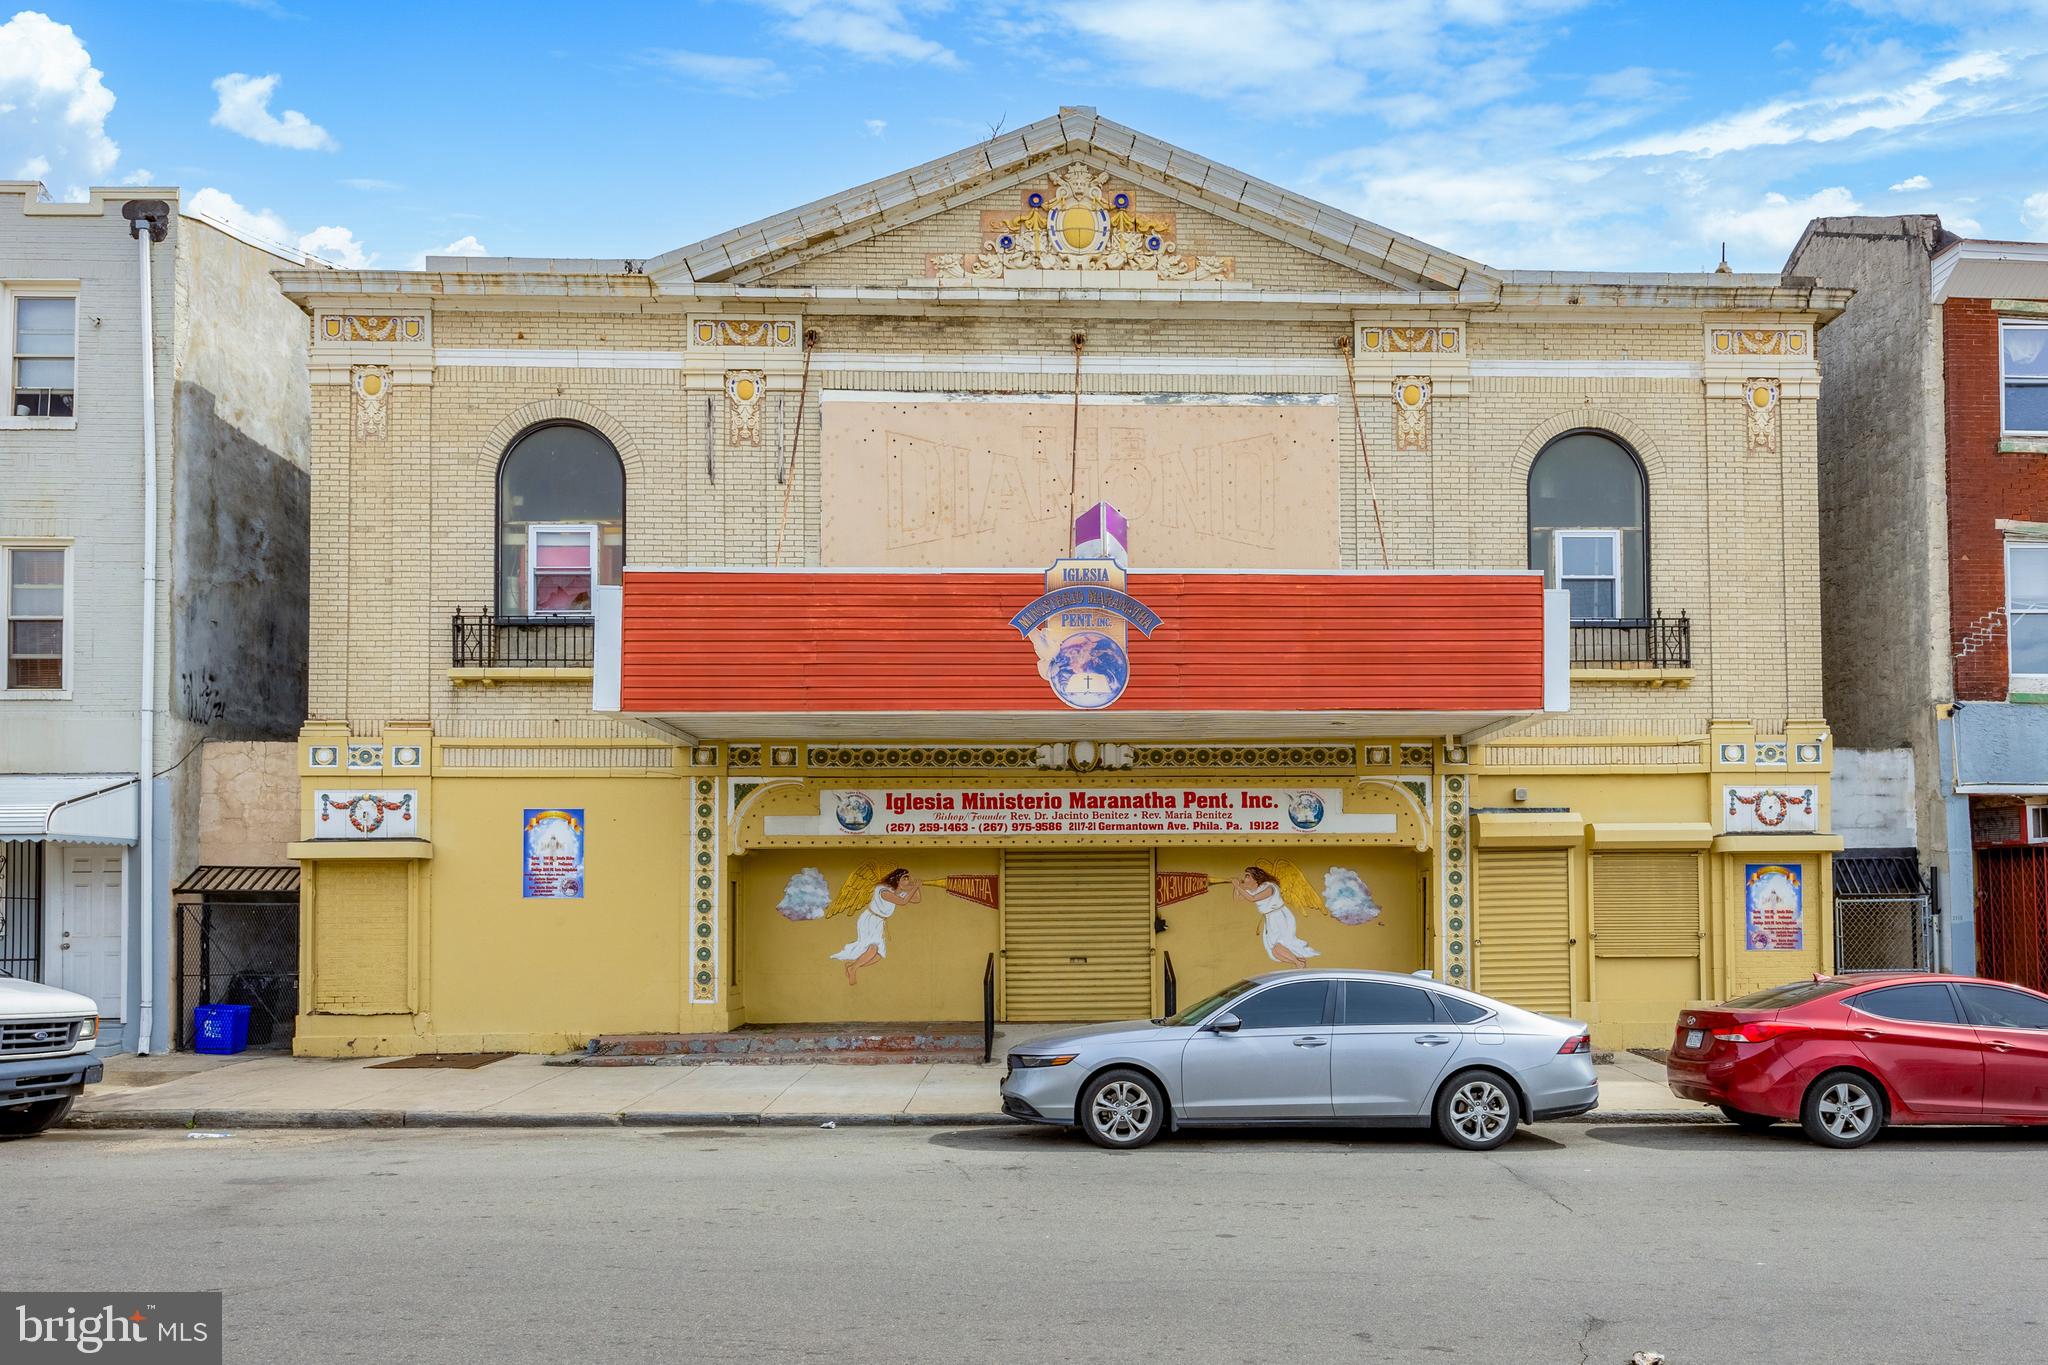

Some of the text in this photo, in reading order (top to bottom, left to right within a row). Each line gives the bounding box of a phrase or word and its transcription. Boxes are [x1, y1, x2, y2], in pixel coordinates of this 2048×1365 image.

[1062, 568, 1110, 582] IGLESIA
[1061, 613, 1095, 627] PENT.
[885, 792, 955, 814] Iglesia
[961, 792, 1063, 810] Ministerio
[1069, 791, 1176, 809] Maranatha
[1183, 791, 1234, 809] Pent.
[1241, 791, 1279, 809] Inc.
[1010, 811, 1031, 821] Rev.
[1034, 811, 1049, 821] Dr.
[1052, 811, 1090, 820] Jacinto
[1092, 810, 1130, 820] Benitez
[1141, 810, 1162, 820] Rev.
[1196, 810, 1233, 820] Benitez
[885, 822, 916, 833] (267)
[918, 823, 969, 832] 259-1463
[978, 822, 1008, 833] (267)
[1011, 822, 1063, 832] 975-9586
[1099, 822, 1164, 831] Germantown
[1167, 822, 1190, 831] Ave.
[1193, 822, 1223, 831] Phila.
[1226, 822, 1243, 831] Pa.
[1249, 821, 1279, 831] 19122
[946, 878, 993, 903] MARANATHA
